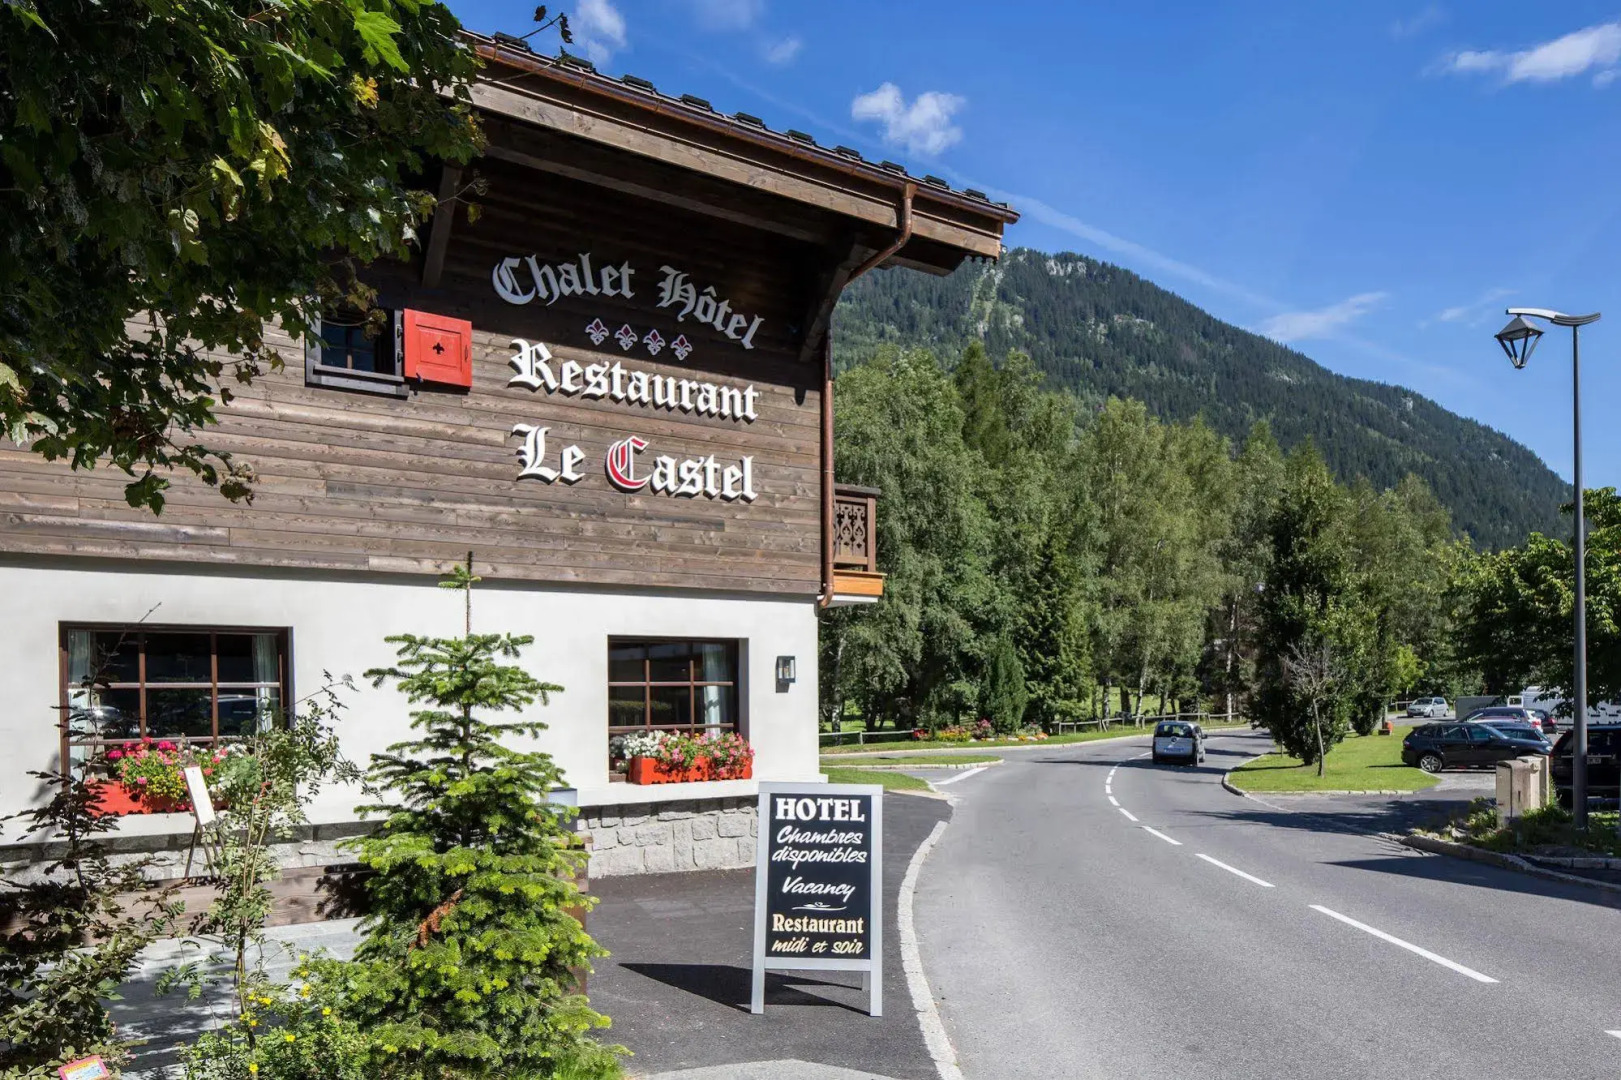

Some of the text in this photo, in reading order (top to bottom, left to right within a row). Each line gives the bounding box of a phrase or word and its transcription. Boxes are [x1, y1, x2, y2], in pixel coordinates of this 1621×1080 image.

[493, 253, 764, 349] Chalet Hôtel
[509, 339, 759, 420] Restaurant
[512, 424, 757, 500] Le Castel
[775, 798, 864, 822] HOTEL
[777, 826, 862, 844] Chambres
[773, 847, 866, 869] disponibles
[783, 877, 855, 902] Vacancy
[772, 915, 863, 933] Restaurant
[773, 938, 863, 954] midi et soir
